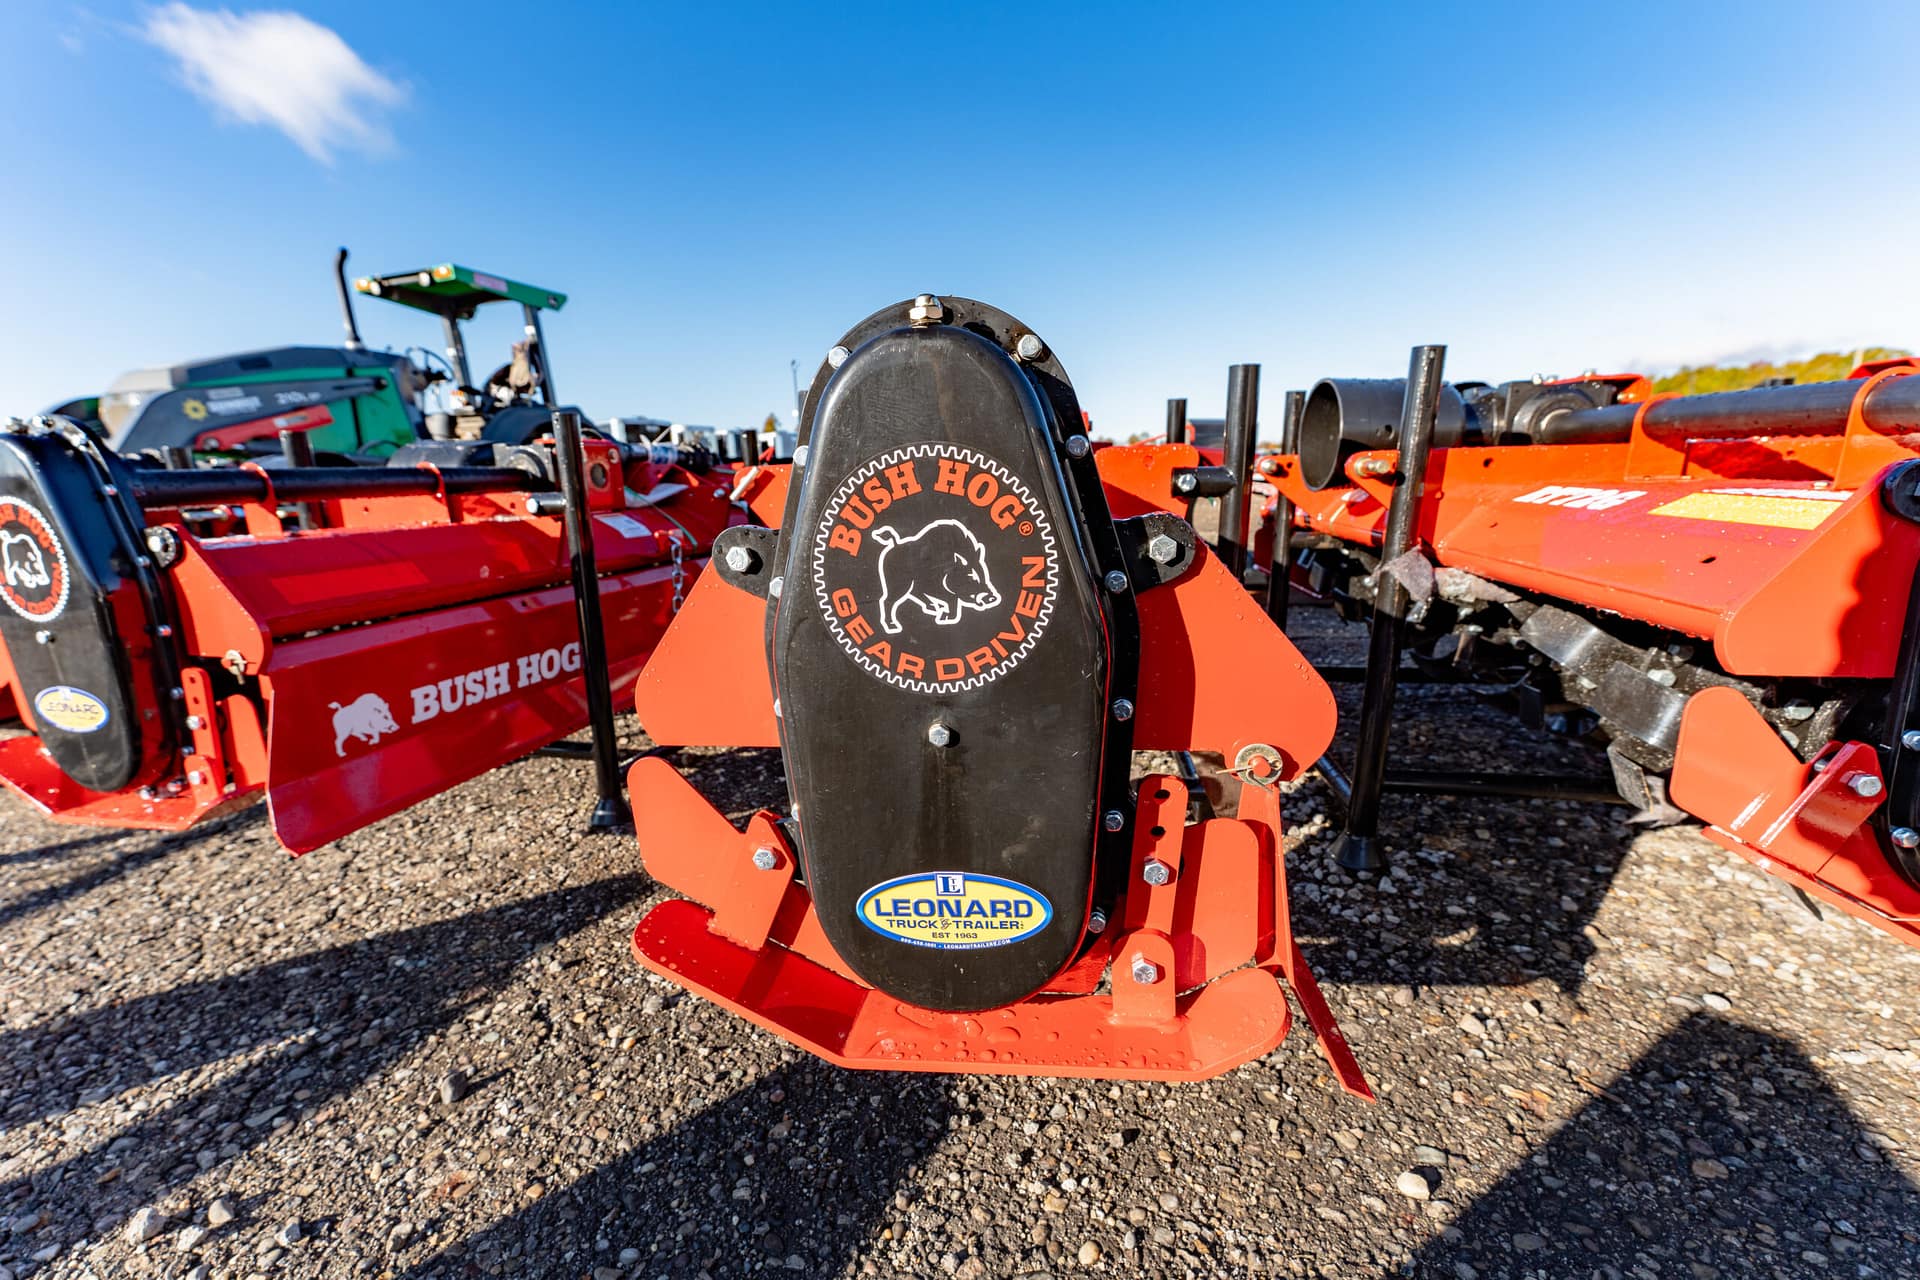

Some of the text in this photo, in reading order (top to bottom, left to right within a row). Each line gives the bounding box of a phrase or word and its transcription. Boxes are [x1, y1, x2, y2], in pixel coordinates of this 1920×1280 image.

[828, 460, 923, 558] BUSH
[832, 556, 1046, 681] GEAR DRIVEN
[410, 641, 581, 724] BUSH HOG
[874, 898, 1034, 918] LEONARD
[886, 919, 939, 929] TRUCK
[952, 920, 1020, 930] TRAILER
